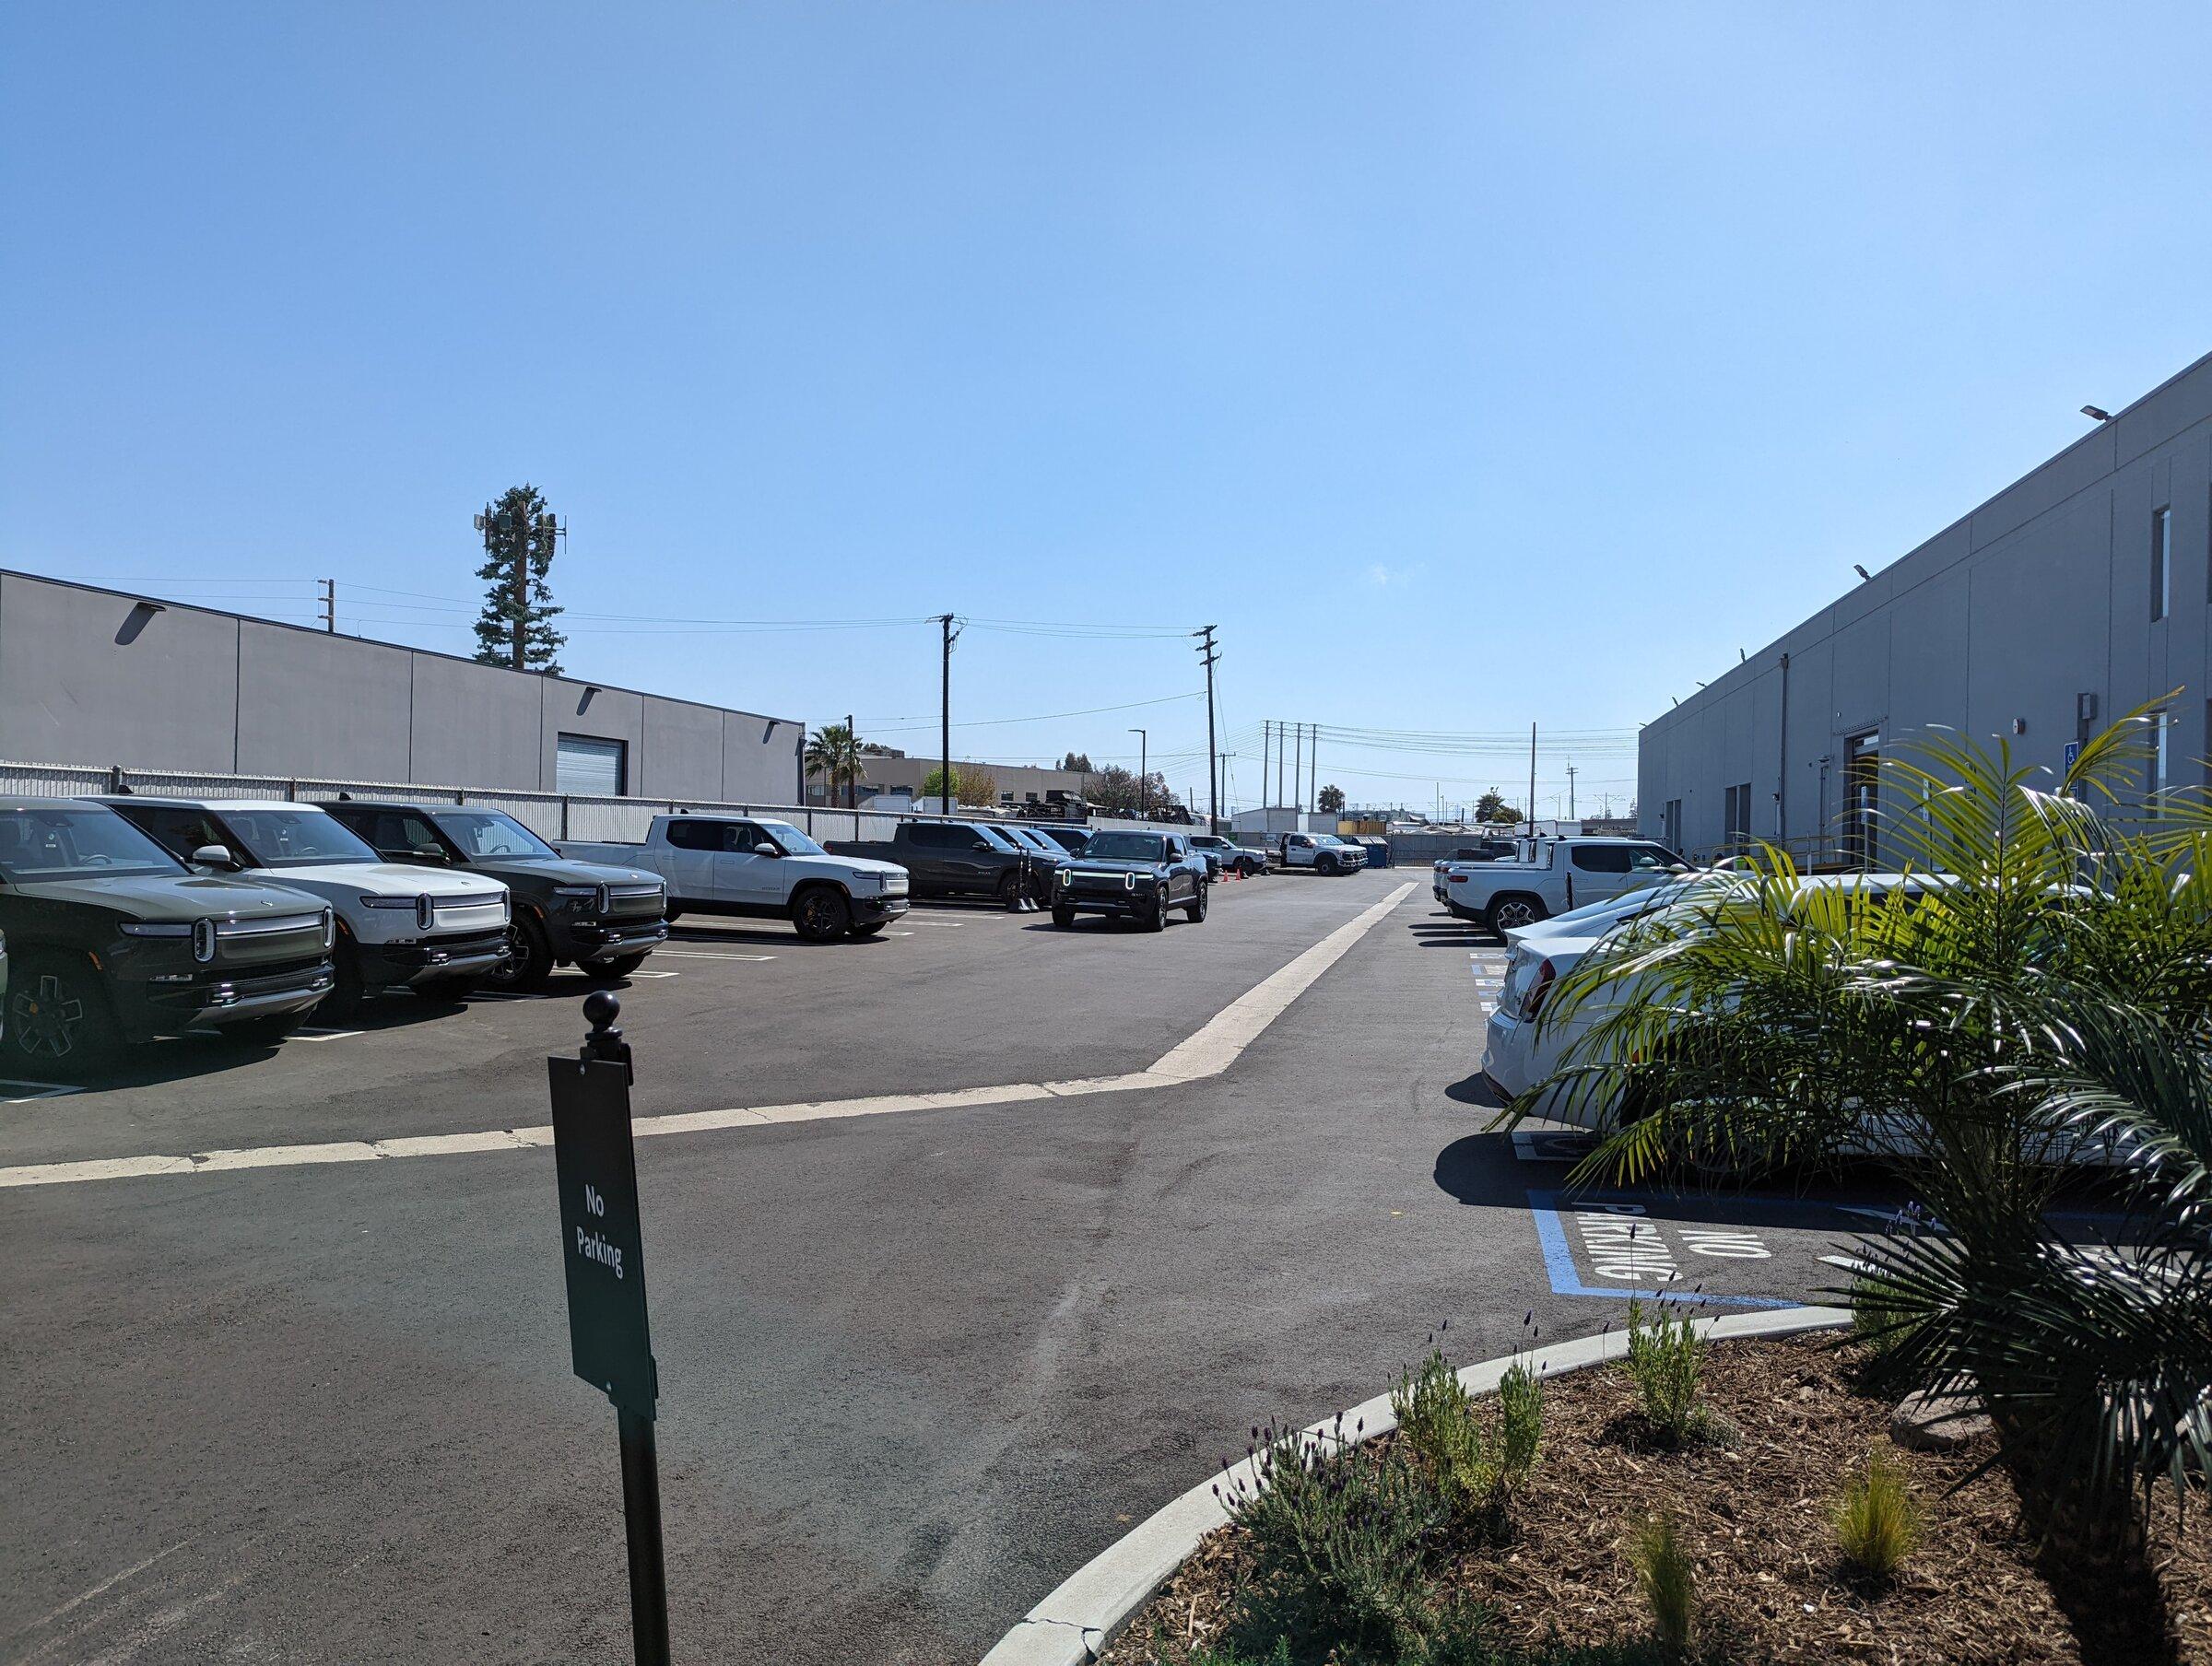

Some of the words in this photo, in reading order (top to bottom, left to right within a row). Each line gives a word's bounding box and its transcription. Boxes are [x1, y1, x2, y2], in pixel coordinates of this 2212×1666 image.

[585, 1184, 605, 1217] No
[576, 1226, 624, 1280] Parking
[1571, 1202, 1684, 1282] PARKING
[1677, 1229, 1771, 1259] NO
